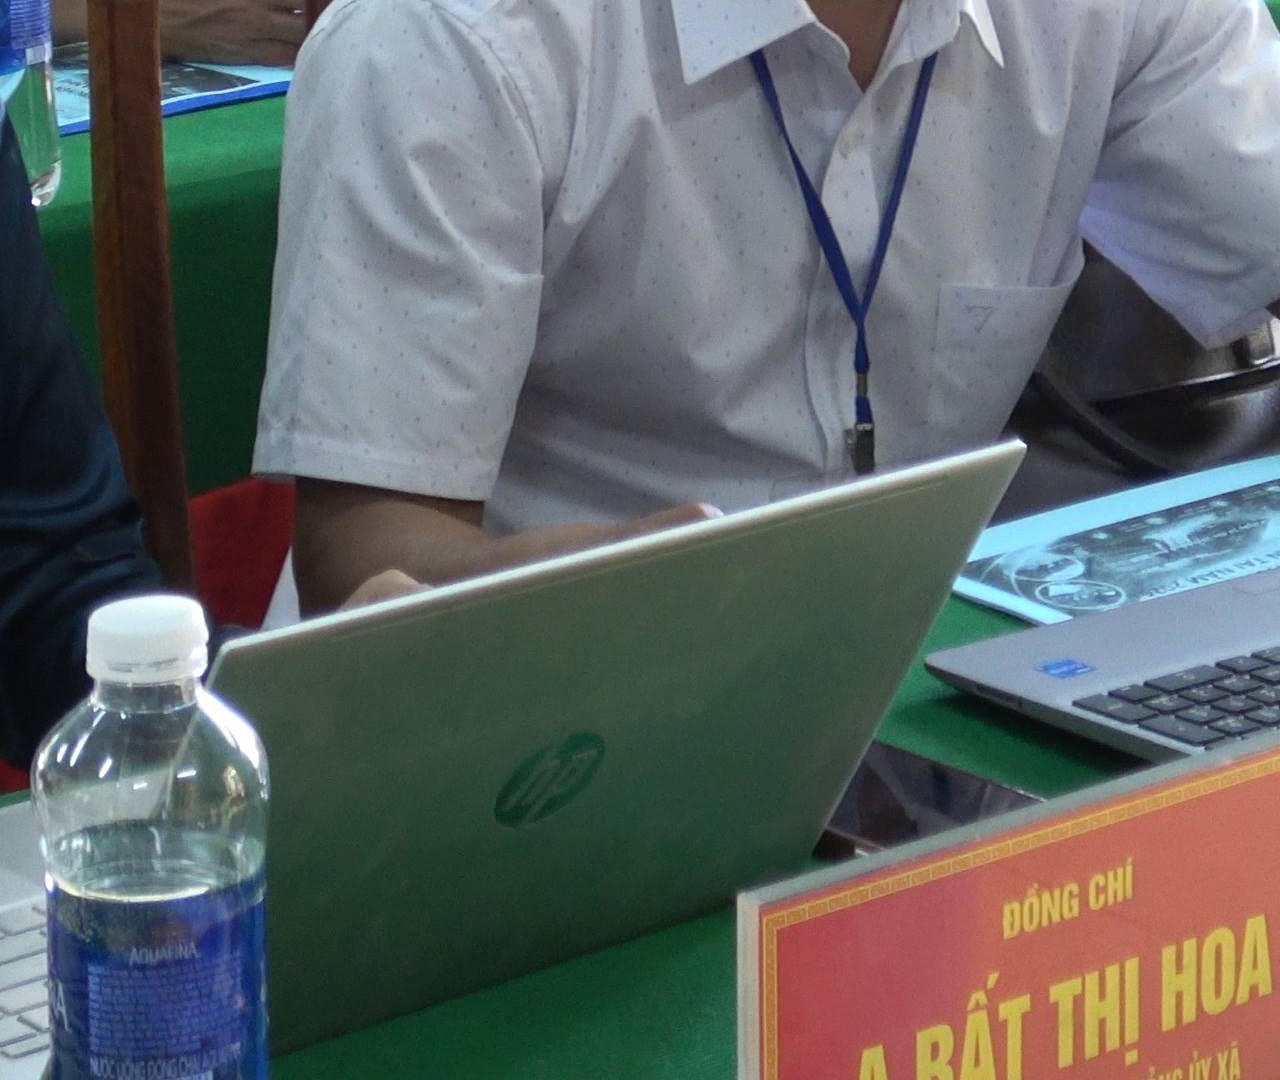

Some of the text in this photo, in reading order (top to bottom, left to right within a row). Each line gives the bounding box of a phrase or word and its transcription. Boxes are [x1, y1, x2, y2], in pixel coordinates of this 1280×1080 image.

[1002, 857, 1134, 940] ĐỒNG CHÍ
[129, 942, 199, 965] AQUAFINA
[1048, 956, 1140, 1069] THỊ
[1160, 913, 1273, 1033] HOA
